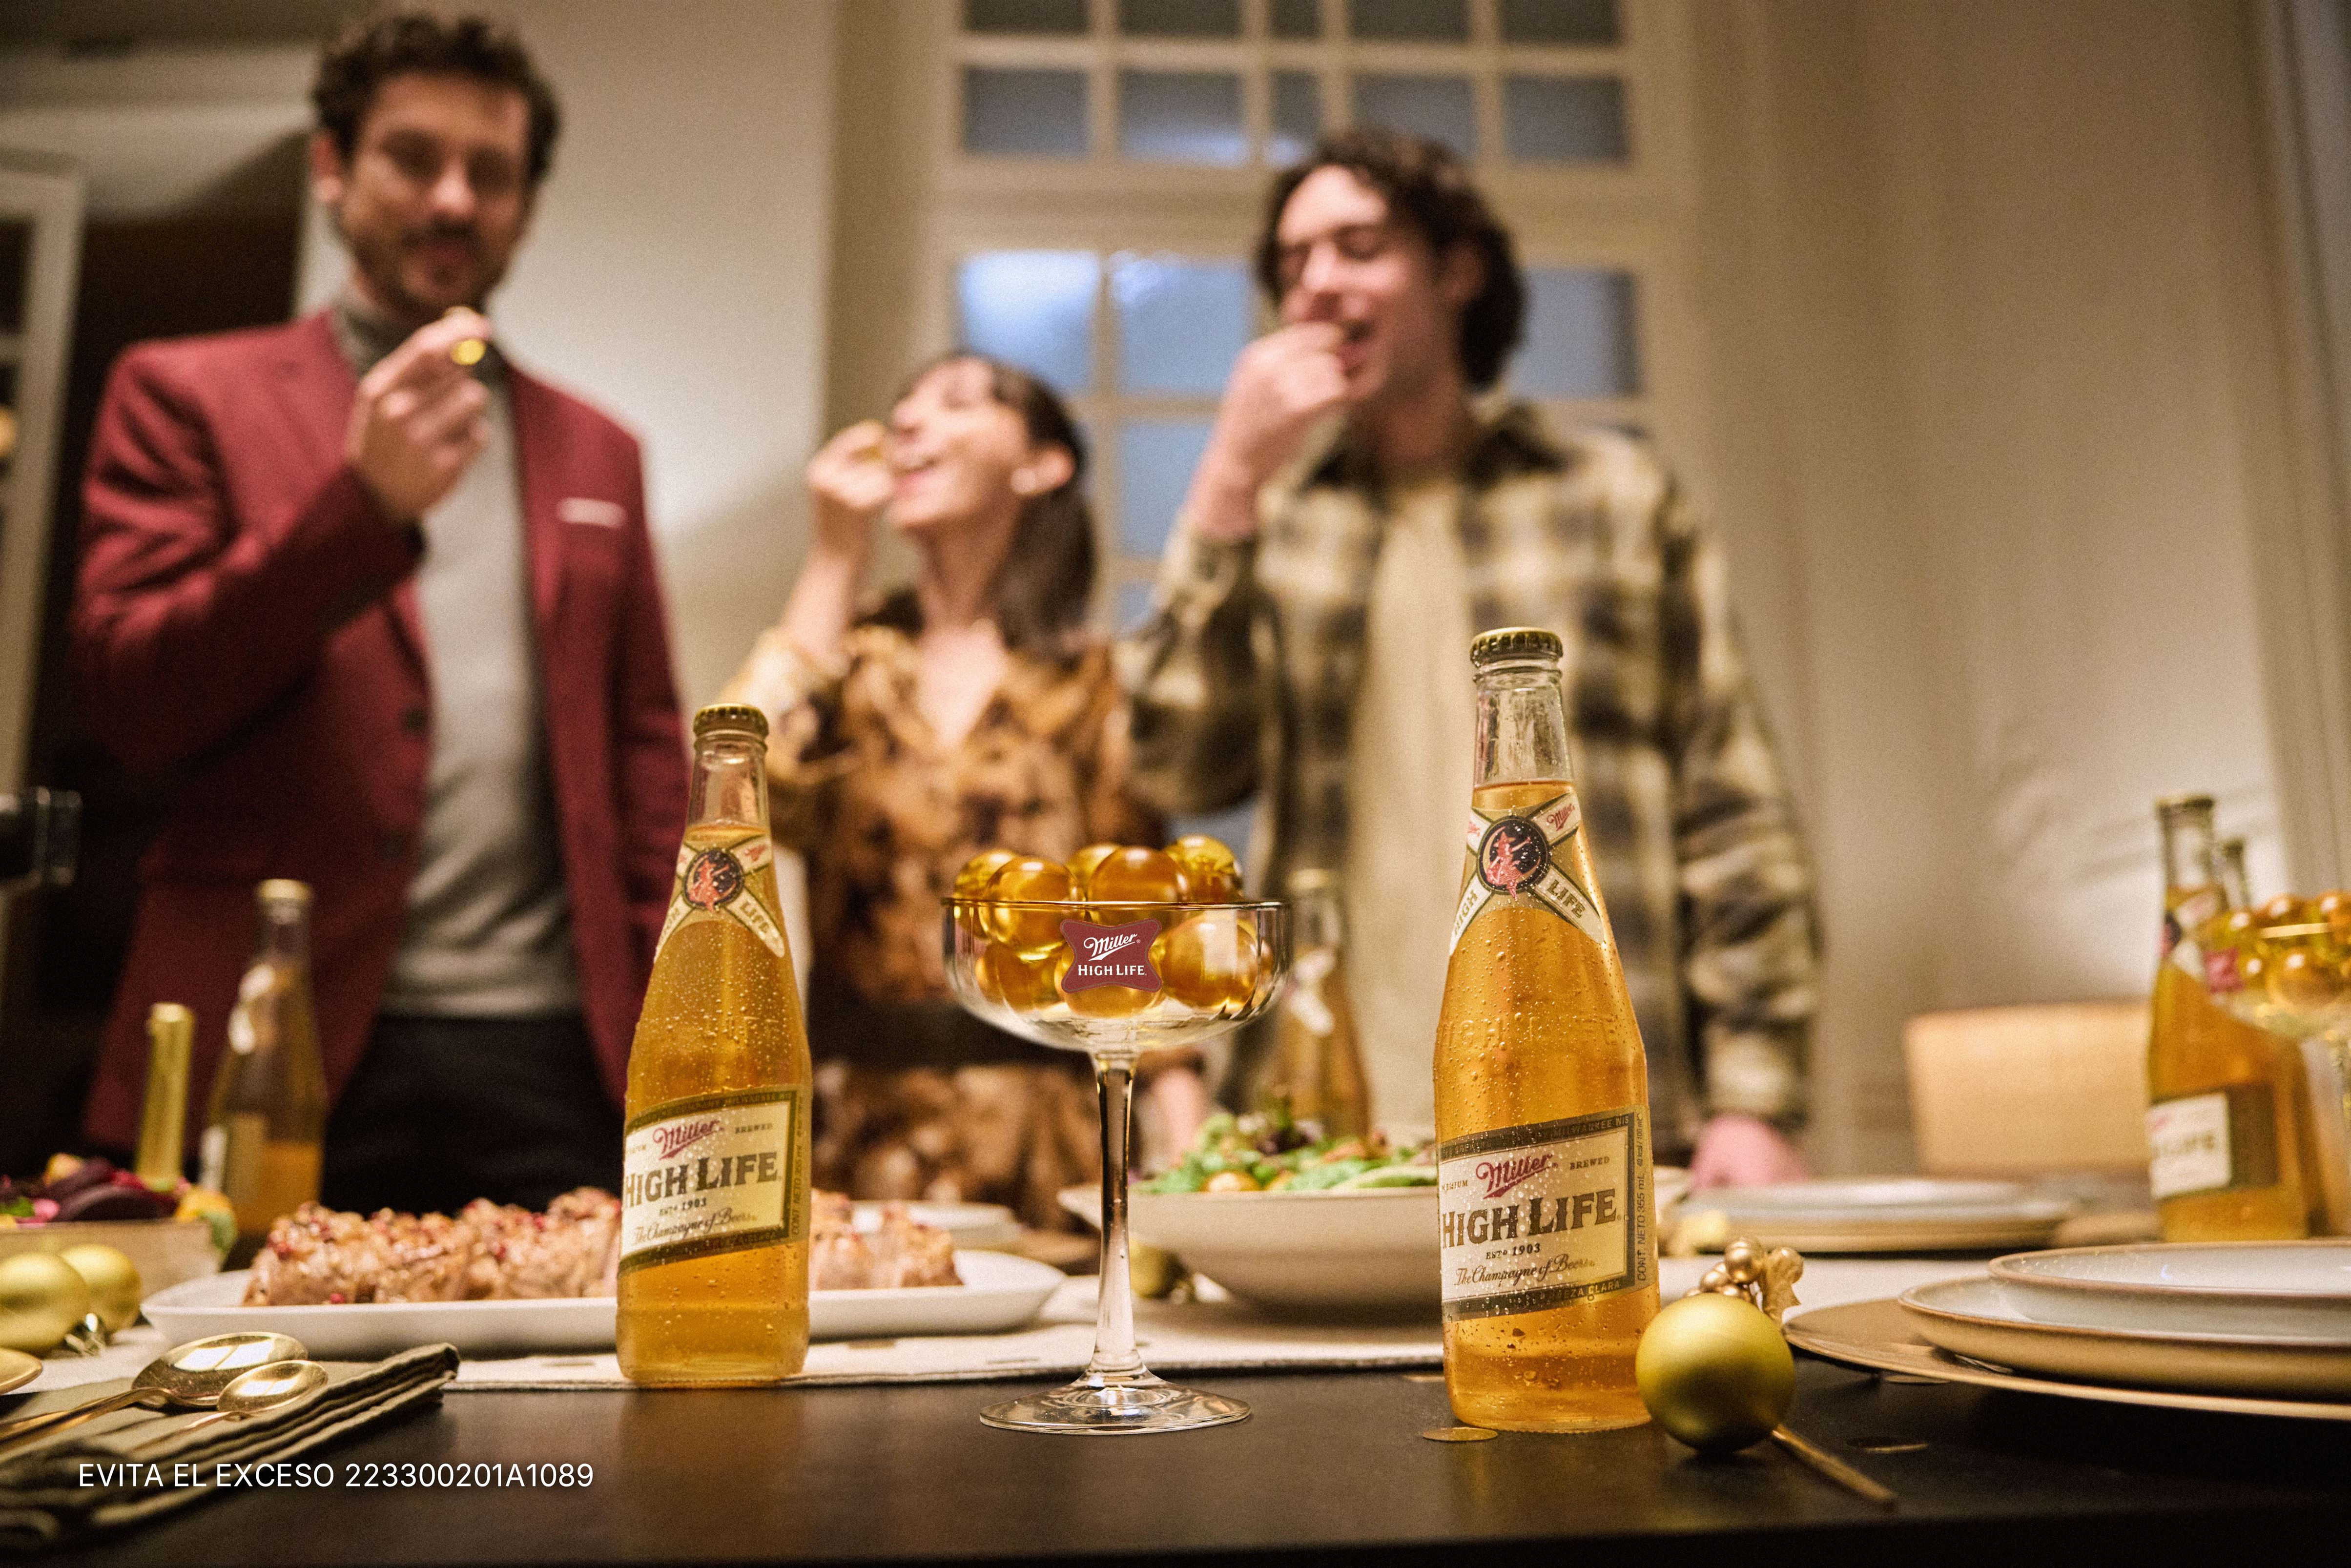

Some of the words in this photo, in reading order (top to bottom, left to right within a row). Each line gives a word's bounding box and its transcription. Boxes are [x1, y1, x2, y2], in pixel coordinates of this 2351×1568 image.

[1547, 879, 1586, 918] LIFE
[1084, 933, 1138, 961] Miller
[1078, 964, 1113, 976] HIGH
[1116, 964, 1145, 975] LIFE
[652, 1119, 721, 1160] Miller
[1476, 1153, 1553, 1199] Miller
[1569, 1156, 1610, 1170] BREWED
[625, 1164, 689, 1208] HIGH
[696, 1152, 778, 1191] LIFE
[682, 1197, 707, 1211] 1903
[1637, 1192, 1645, 1213] 355
[1442, 1204, 1519, 1249] HIGH
[1526, 1189, 1617, 1237] LIFE
[1637, 1215, 1646, 1244] NETO
[1512, 1242, 1540, 1256] 1903
[1454, 1268, 1471, 1286] The
[1472, 1265, 1537, 1287] Champagne
[1537, 1257, 1553, 1282] of
